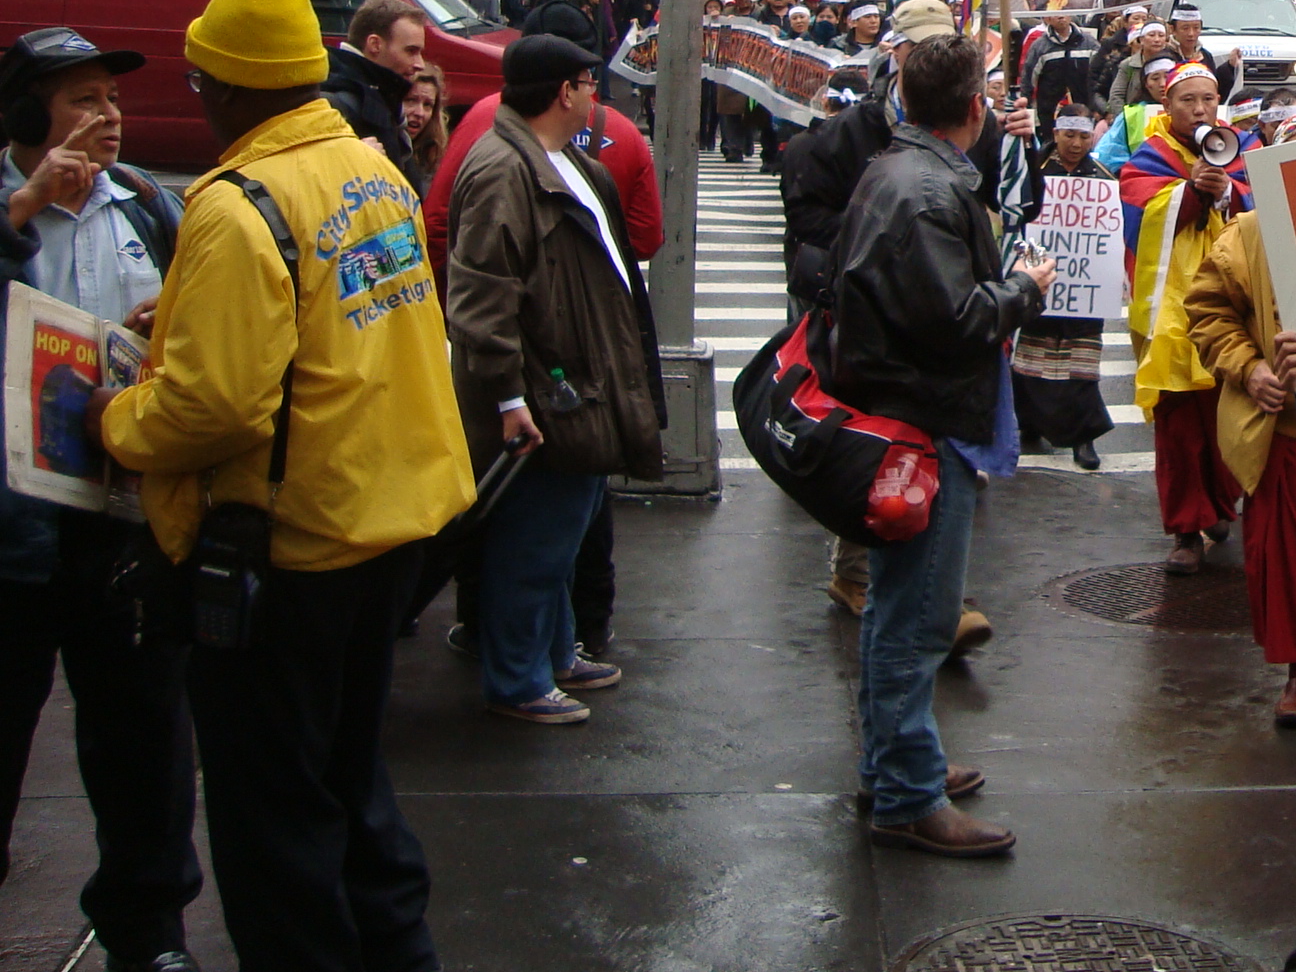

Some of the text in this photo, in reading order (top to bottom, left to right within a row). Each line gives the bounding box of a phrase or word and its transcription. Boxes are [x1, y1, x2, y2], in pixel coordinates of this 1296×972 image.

[1240, 49, 1274, 58] OLICE
[1041, 229, 1111, 255] UNITE
[1055, 255, 1091, 280] FOR
[1051, 282, 1101, 314] BET
[36, 330, 71, 356] HOP
[75, 343, 97, 366] ON
